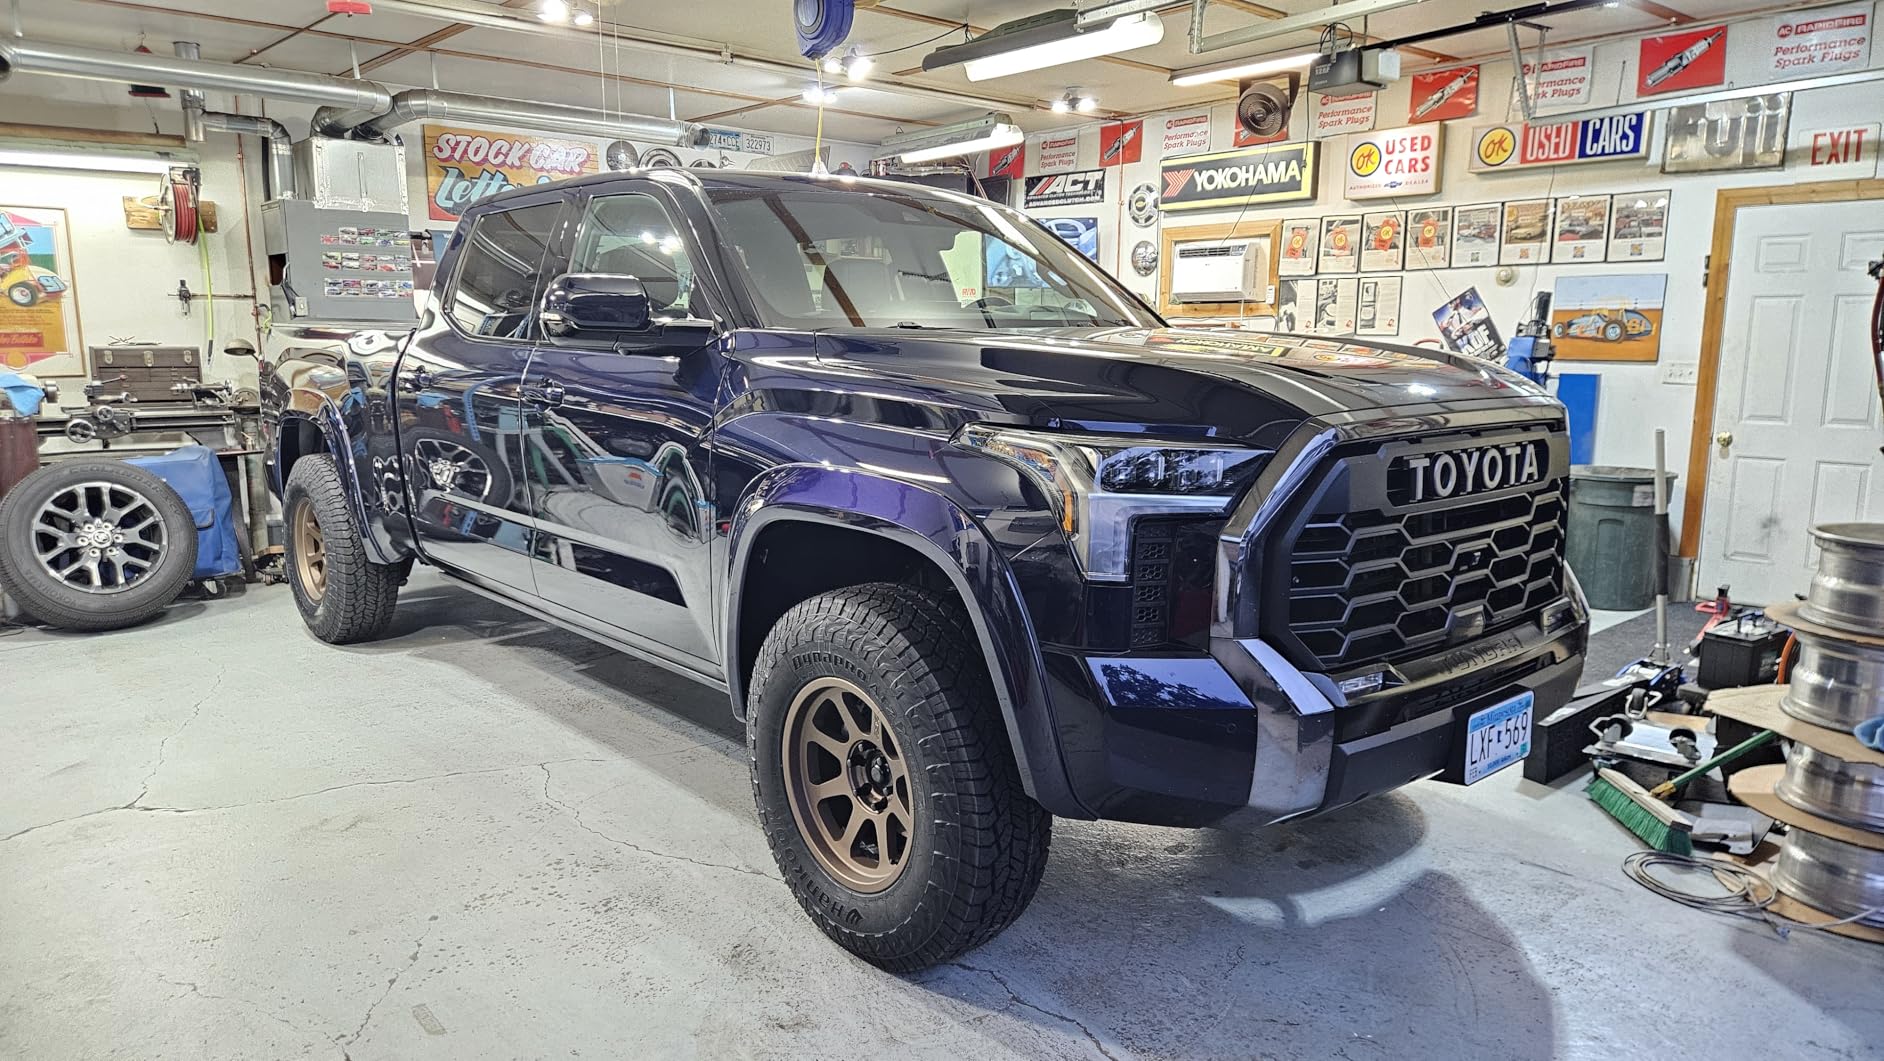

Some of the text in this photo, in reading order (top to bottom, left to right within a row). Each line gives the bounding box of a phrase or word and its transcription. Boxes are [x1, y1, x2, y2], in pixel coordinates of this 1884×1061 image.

[1779, 16, 1866, 36] AC RAPIDFIRE
[1774, 37, 1866, 56] Performance
[1775, 50, 1861, 69] Spark Plugs
[1537, 76, 1586, 89] rmance
[1551, 88, 1582, 98] Plugs
[1318, 106, 1373, 119] Performance
[1319, 115, 1370, 129] Spark Plugs
[746, 138, 771, 152] 322973
[1164, 139, 1207, 150] Spark Plugs
[1385, 135, 1432, 155] USED
[1485, 134, 1509, 160] OK
[1526, 114, 1635, 161] USED CARS
[1811, 129, 1869, 166] EXIT
[432, 132, 592, 175] STOCK CAR
[1356, 148, 1376, 170] OK
[1384, 156, 1430, 175] CARS
[1042, 171, 1104, 195] ACT
[1194, 159, 1302, 193] YOKOHAMA
[1408, 443, 1539, 502] TOYOTA
[1470, 710, 1529, 767] LXF 569
